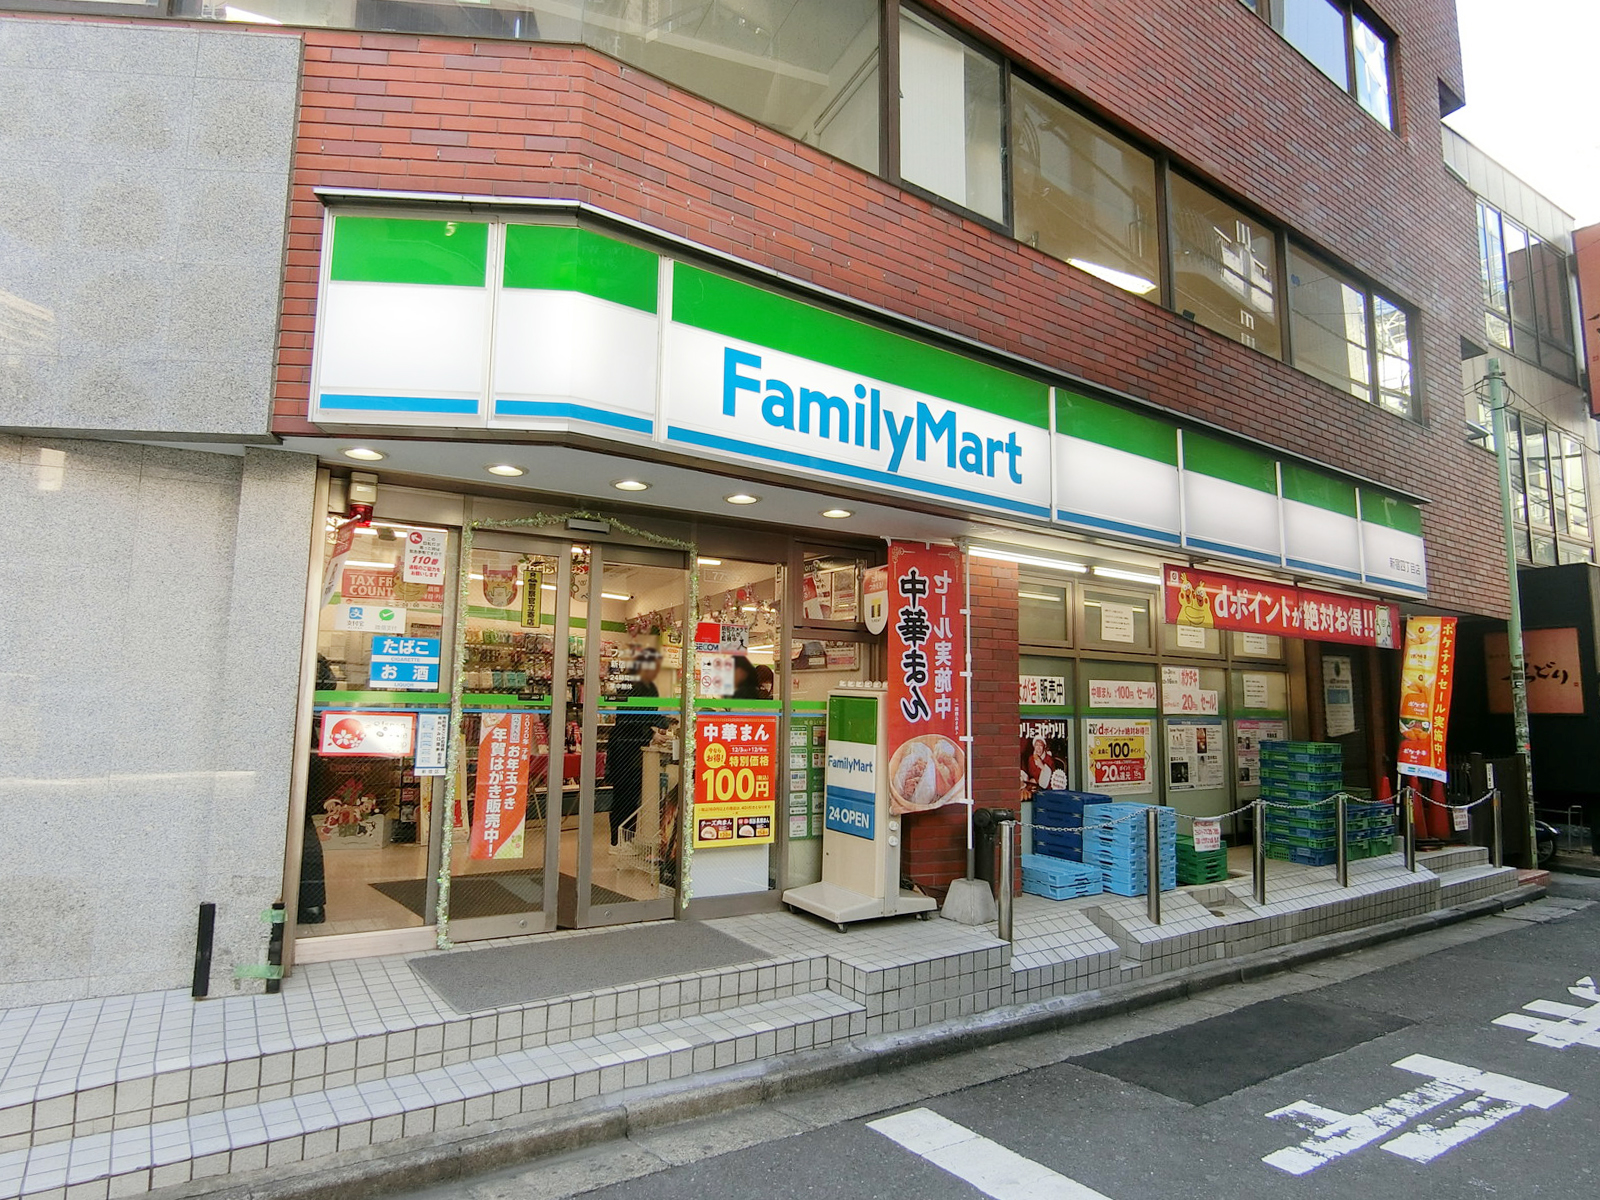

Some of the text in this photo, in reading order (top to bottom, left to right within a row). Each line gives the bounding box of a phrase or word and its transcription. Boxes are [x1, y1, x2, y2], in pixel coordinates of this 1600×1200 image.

[722, 346, 1023, 484] FamilyMart
[412, 556, 439, 565] 110番
[350, 574, 374, 585] TAX
[1214, 584, 1375, 638] dポイントが絶対お得!!
[382, 639, 430, 655] たばこ
[380, 664, 430, 681] お 酒
[1040, 678, 1063, 703] 販売中
[1432, 624, 1454, 767] ポケチキセール実施中!
[520, 714, 531, 761] 2020年 子年
[703, 723, 769, 742] 中華まん
[706, 755, 725, 763] お得!
[1108, 742, 1130, 758] 100
[729, 756, 769, 767] 特別価格
[827, 755, 873, 774] FamilyMart
[503, 745, 521, 811] お年玉つき
[483, 727, 508, 858] 年賀はがき販売中!
[700, 819, 733, 827] チーズ肉まん
